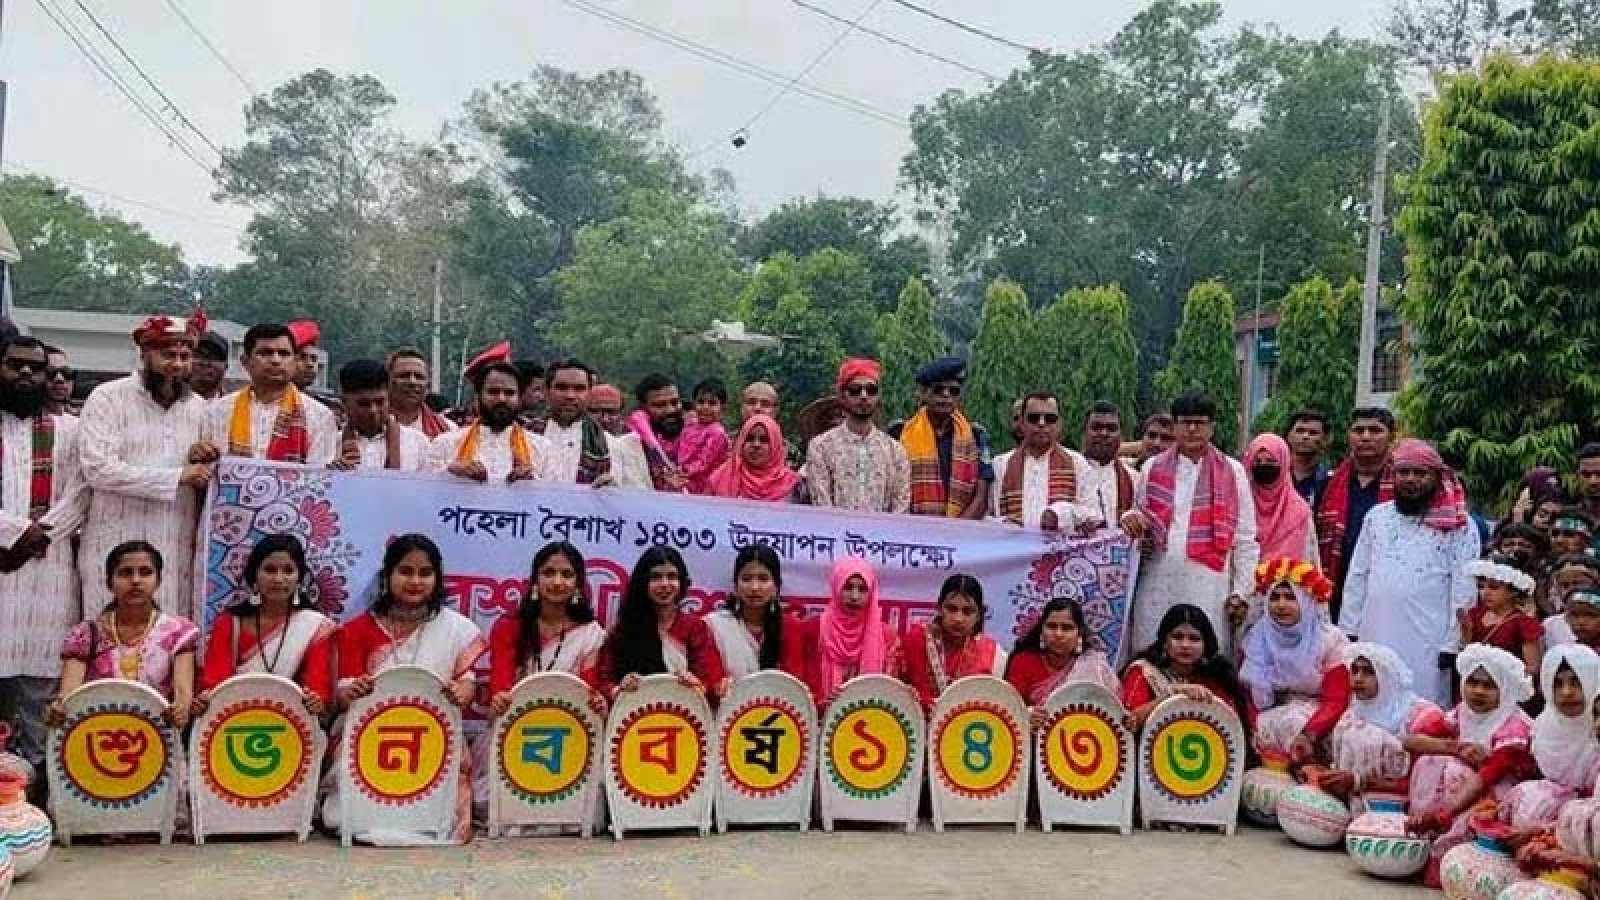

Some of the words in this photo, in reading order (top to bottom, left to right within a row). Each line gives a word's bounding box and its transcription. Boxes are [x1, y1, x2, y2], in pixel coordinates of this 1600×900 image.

[438, 506, 531, 538] পহেলা
[538, 504, 627, 544] বৈশাখ
[634, 521, 717, 550] ১৪৩৩
